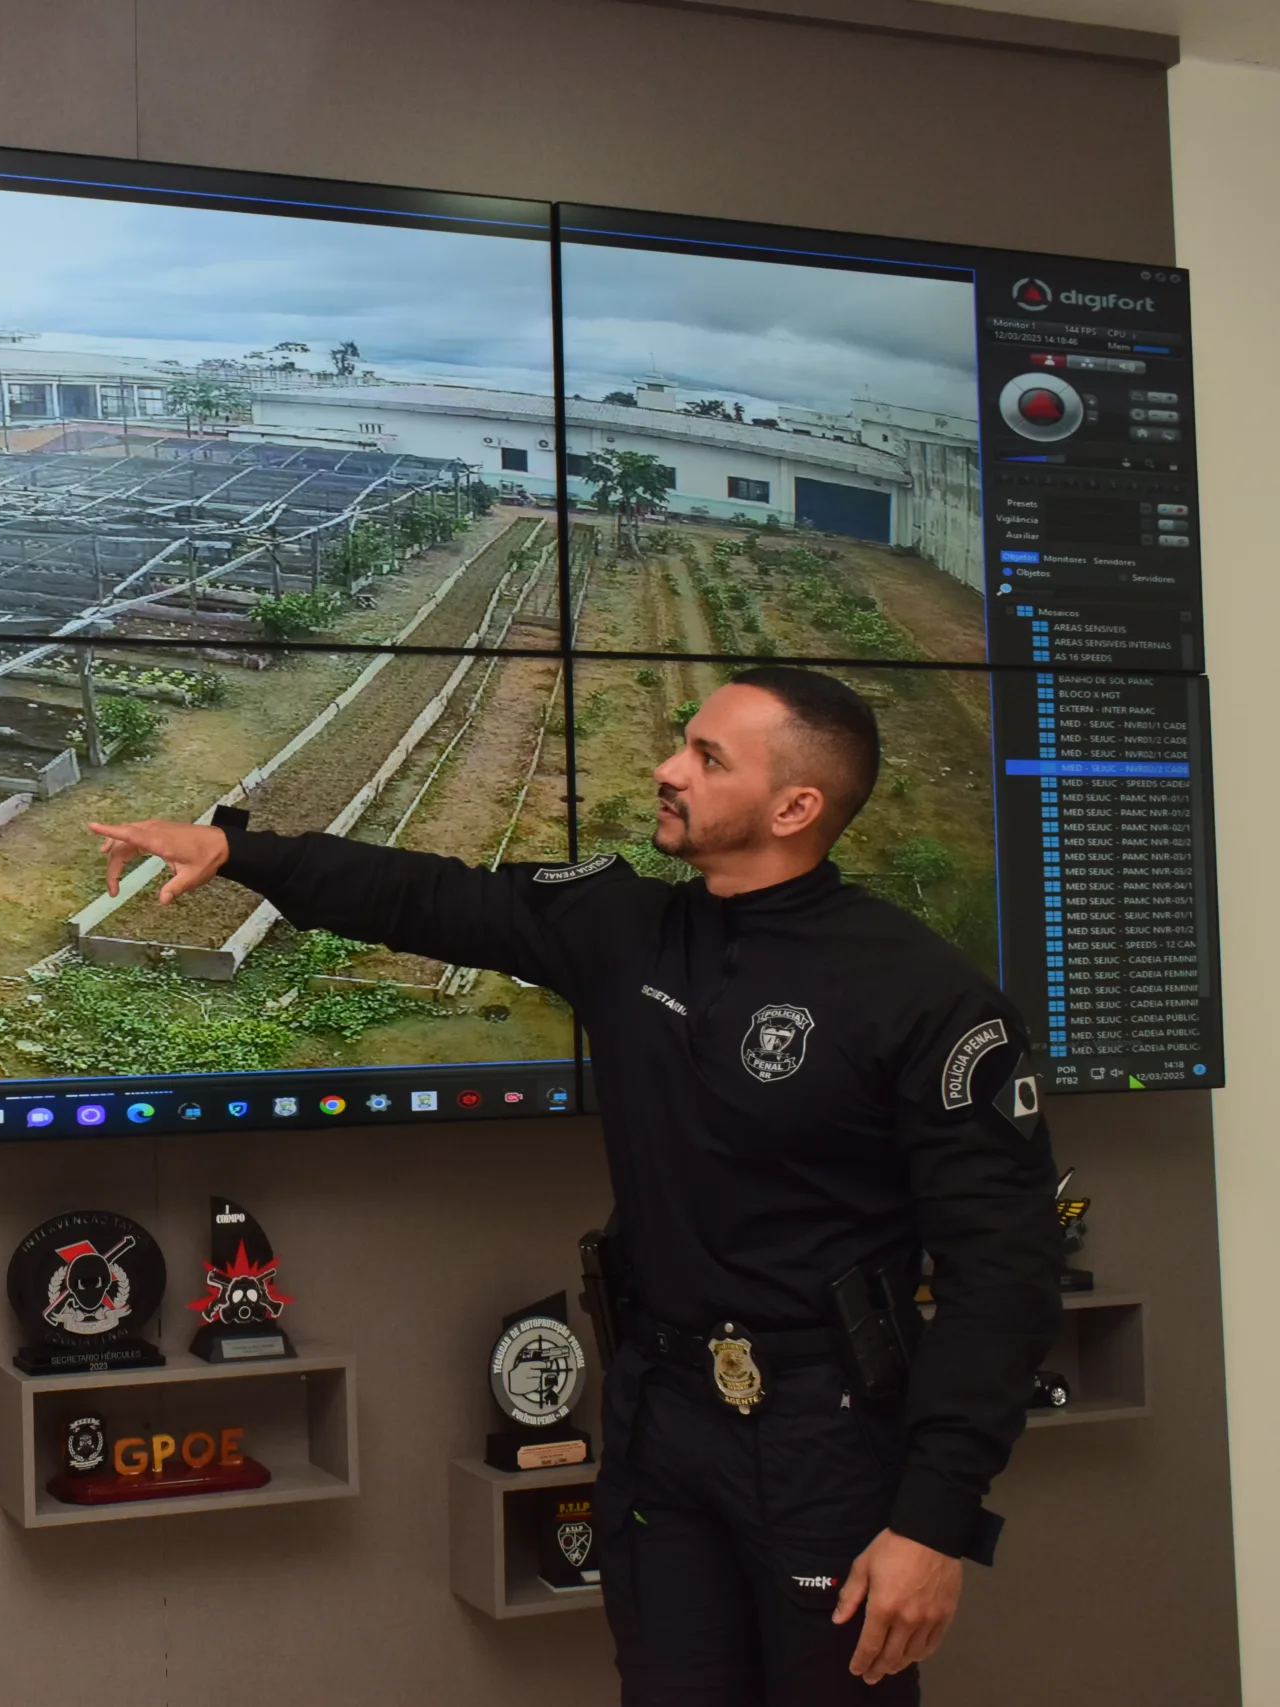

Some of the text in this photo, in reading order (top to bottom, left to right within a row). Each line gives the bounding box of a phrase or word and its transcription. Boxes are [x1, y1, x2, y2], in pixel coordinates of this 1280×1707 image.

[1060, 289, 1155, 312] digifort
[993, 318, 1029, 329] Monitor
[1065, 325, 1079, 334] 144
[1081, 326, 1097, 336] FPS
[1108, 329, 1126, 338] CPU
[995, 331, 1042, 343] 12/03/2025
[1108, 342, 1130, 351] Mem
[1007, 499, 1038, 508] Presets
[996, 514, 1039, 525] Vigilância
[1006, 531, 1039, 540] Auxiliar
[1003, 553, 1136, 566] Objetos Monitores Servidores
[1016, 569, 1175, 584] Objetos Servidores
[1039, 609, 1079, 617] Mosaicos
[1054, 624, 1126, 633] AREAS SENSIVEIS
[1054, 639, 1171, 650] AREAS SENSIVEIS INTERNAS
[1081, 654, 1112, 662] SPEEDS
[1059, 675, 1154, 686] BANHO DE SOL PAMC
[1102, 691, 1120, 699] HGT
[1060, 705, 1155, 715] EXTERN INTER PAMC
[1060, 720, 1080, 728] MED
[1163, 722, 1187, 730] CADE
[1090, 735, 1115, 743] SEJUC
[1163, 737, 1187, 745] CADE
[544, 870, 576, 879] PENAL
[1125, 897, 1150, 905] PAMC
[1091, 927, 1116, 935] SEJUC
[1129, 956, 1162, 964] CADEIA
[754, 1059, 784, 1071] PENAL
[948, 1028, 999, 1098] POLÍCIA PENAL
[759, 1071, 772, 1079] RR
[1137, 1072, 1185, 1080] 12/03/2025
[509, 1327, 520, 1339] DE
[520, 1318, 571, 1338] AUTOPROTEÇÃO
[568, 1335, 585, 1369] POLICIAL
[90, 1362, 108, 1371] 2023
[725, 1395, 759, 1405] AGENTE
[114, 1427, 245, 1475] GPOE
